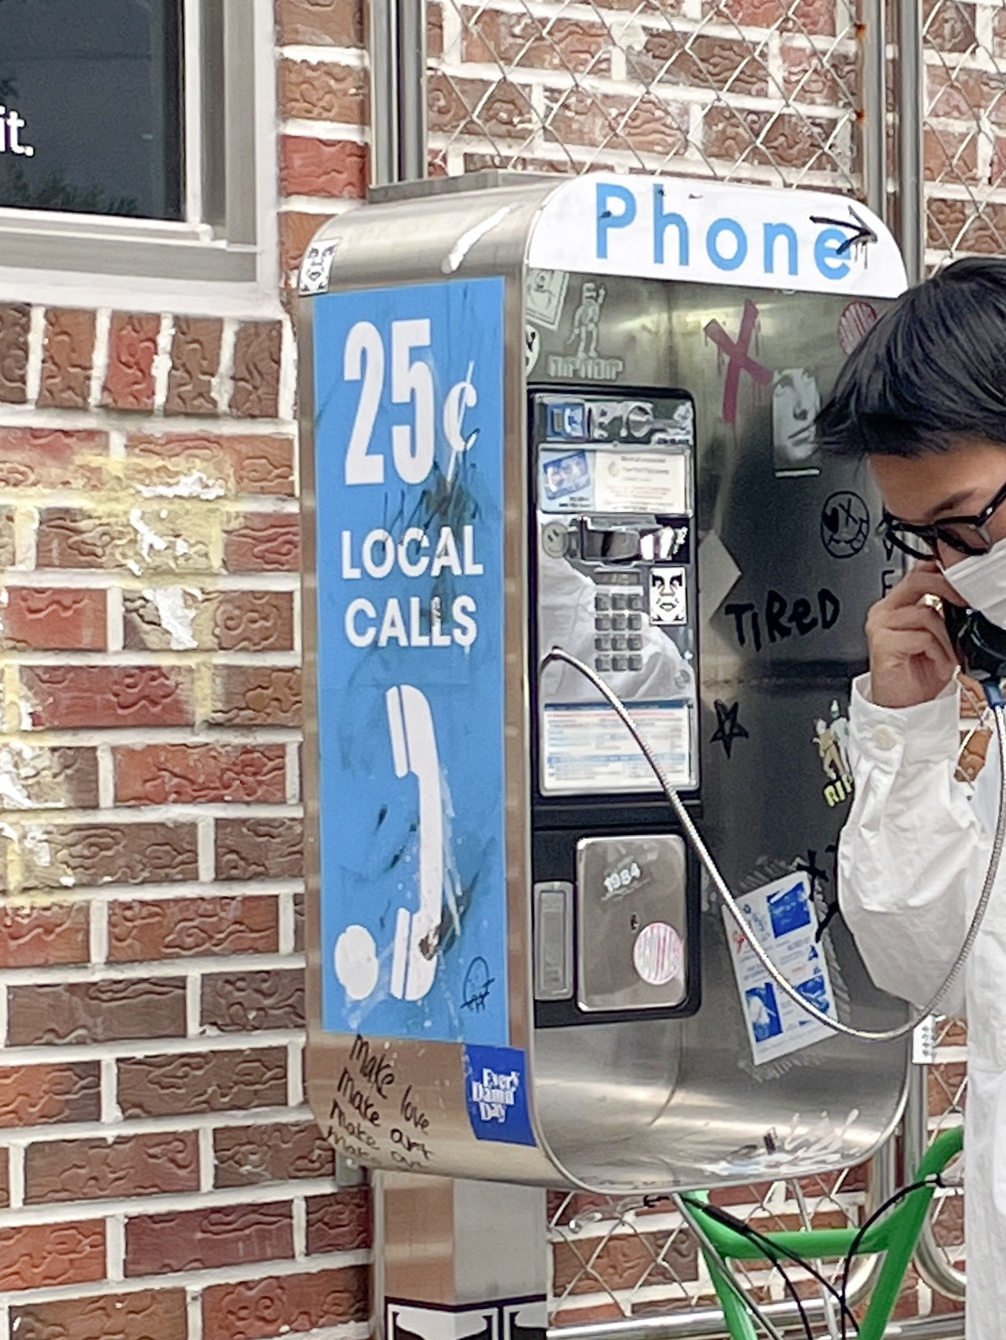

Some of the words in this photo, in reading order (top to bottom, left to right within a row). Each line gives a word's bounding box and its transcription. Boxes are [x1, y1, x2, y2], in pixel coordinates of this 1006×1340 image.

[596, 181, 851, 281] Phone
[342, 525, 484, 580] LOCAL
[345, 595, 477, 648] CALLS
